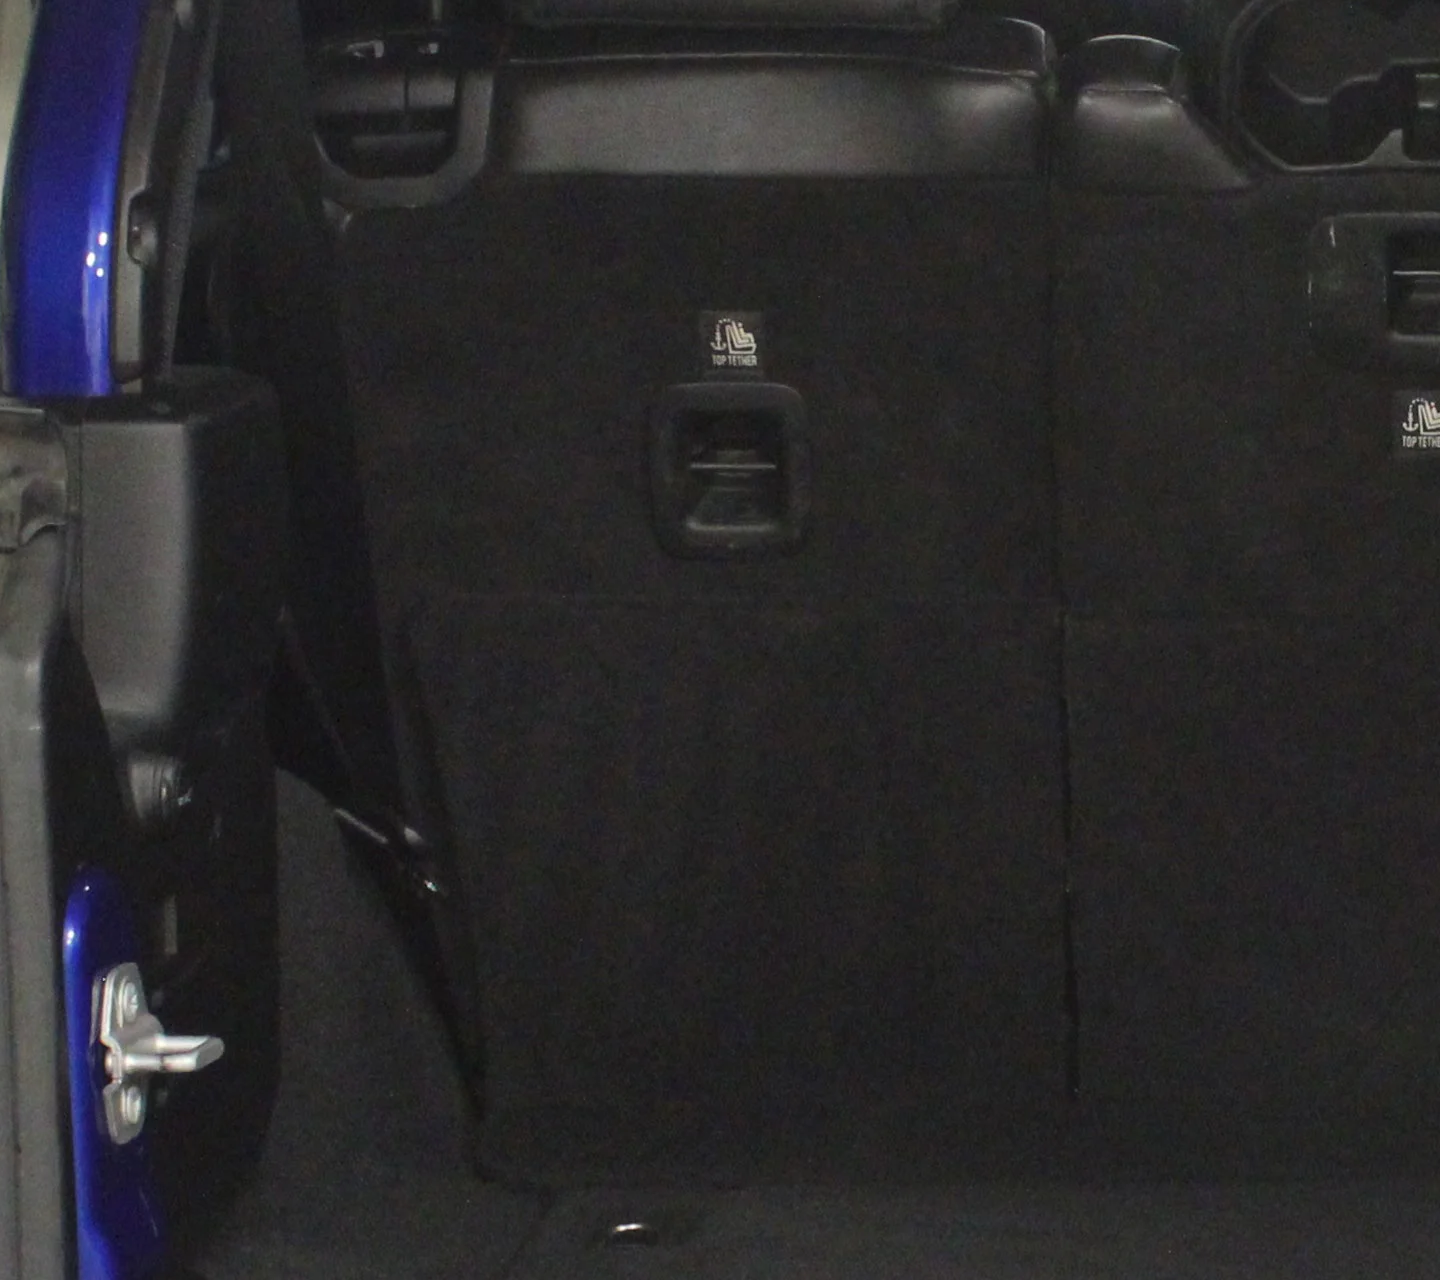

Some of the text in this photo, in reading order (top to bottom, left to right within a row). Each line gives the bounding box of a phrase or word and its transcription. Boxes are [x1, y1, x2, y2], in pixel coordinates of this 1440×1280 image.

[712, 355, 757, 366] TOP TETHER
[1403, 436, 1417, 448] TOP
